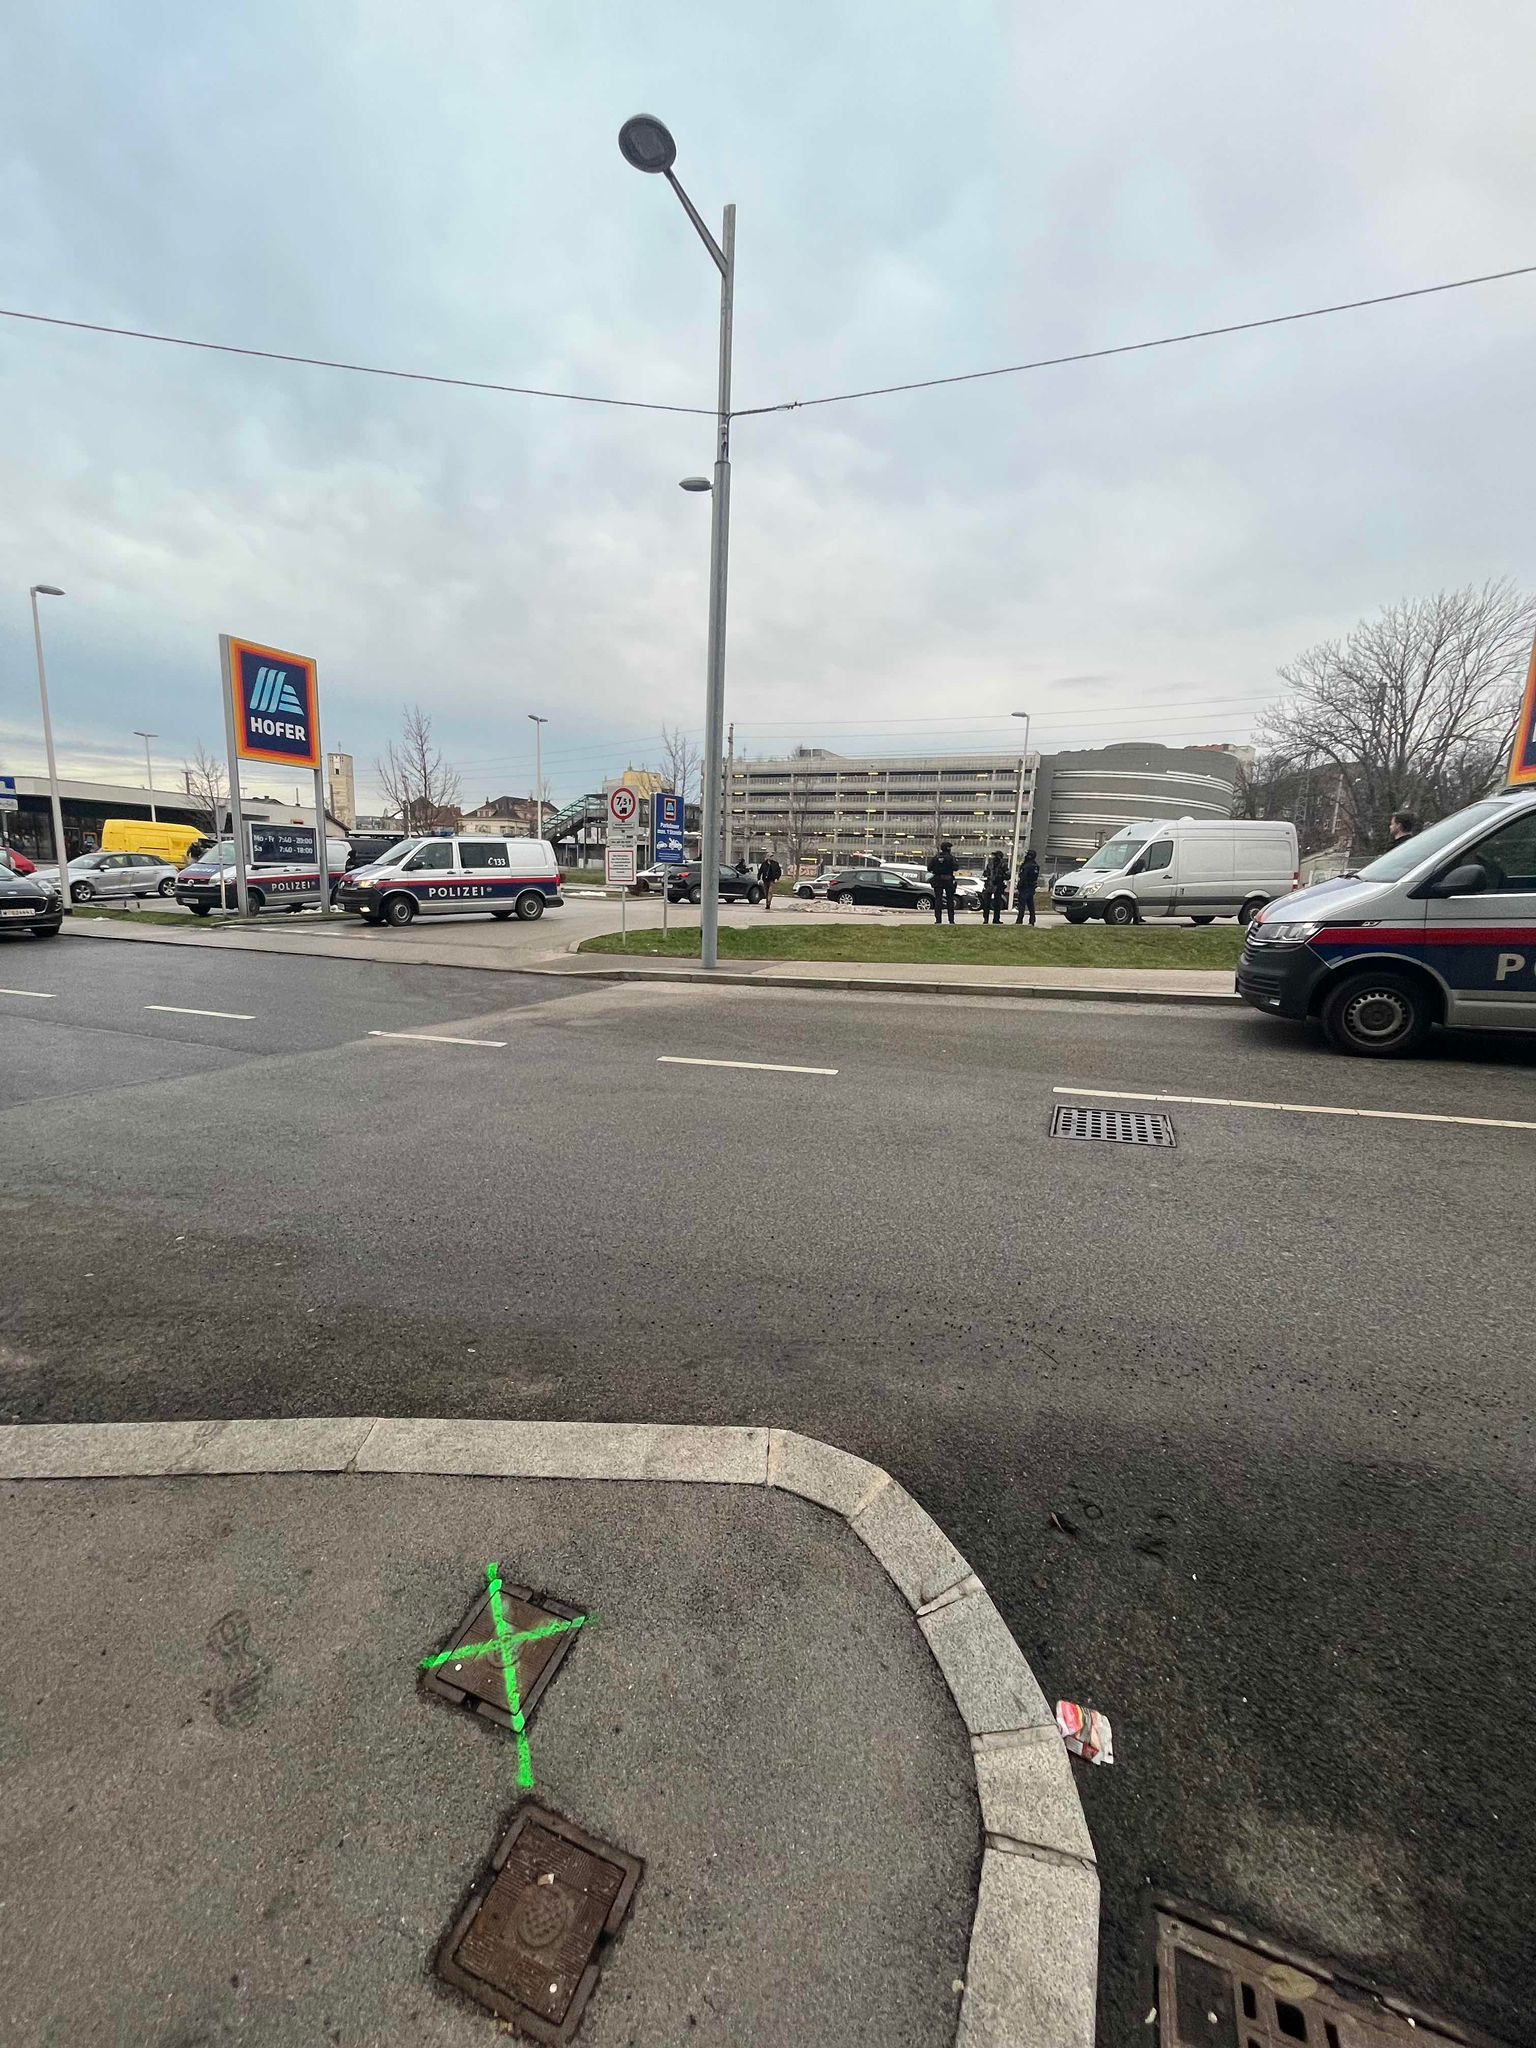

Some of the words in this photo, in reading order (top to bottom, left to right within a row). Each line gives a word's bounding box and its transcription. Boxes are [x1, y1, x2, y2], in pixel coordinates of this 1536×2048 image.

[250, 716, 306, 741] HOFER
[494, 858, 506, 866] 133
[272, 881, 311, 891] POLIZEI
[428, 886, 485, 898] POLIZEI
